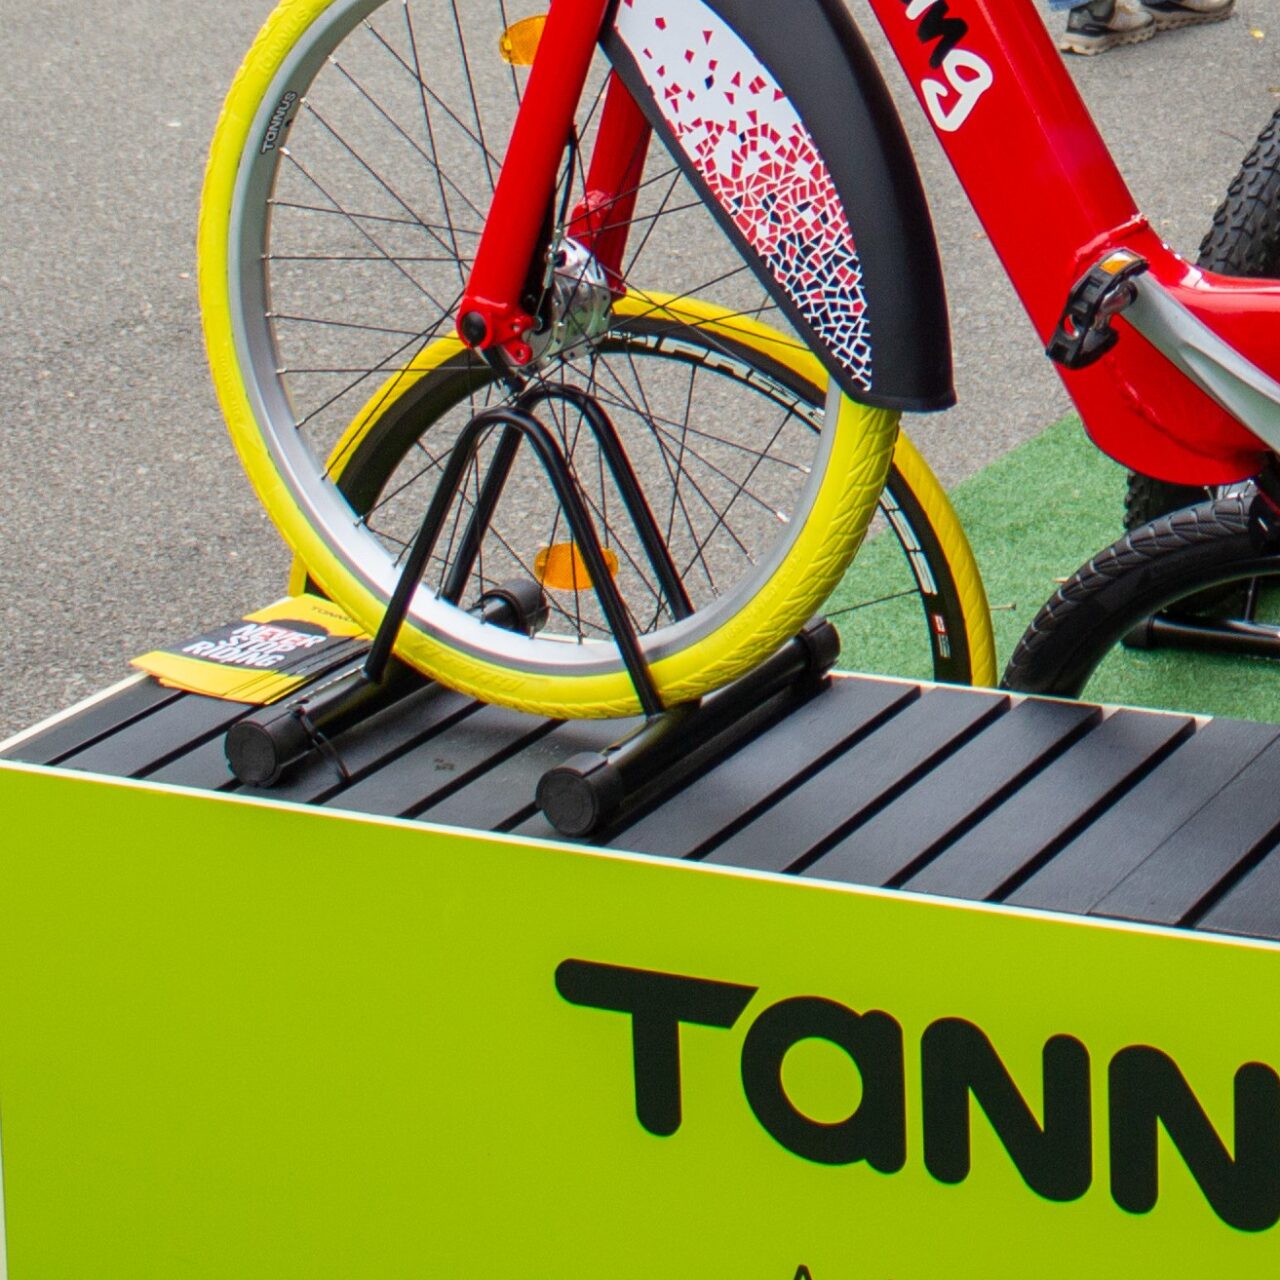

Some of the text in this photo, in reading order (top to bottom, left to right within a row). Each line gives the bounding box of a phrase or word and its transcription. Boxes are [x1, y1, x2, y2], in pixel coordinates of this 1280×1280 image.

[218, 635, 296, 653] STOP
[231, 623, 326, 648] NEVER
[182, 640, 285, 667] RIDING
